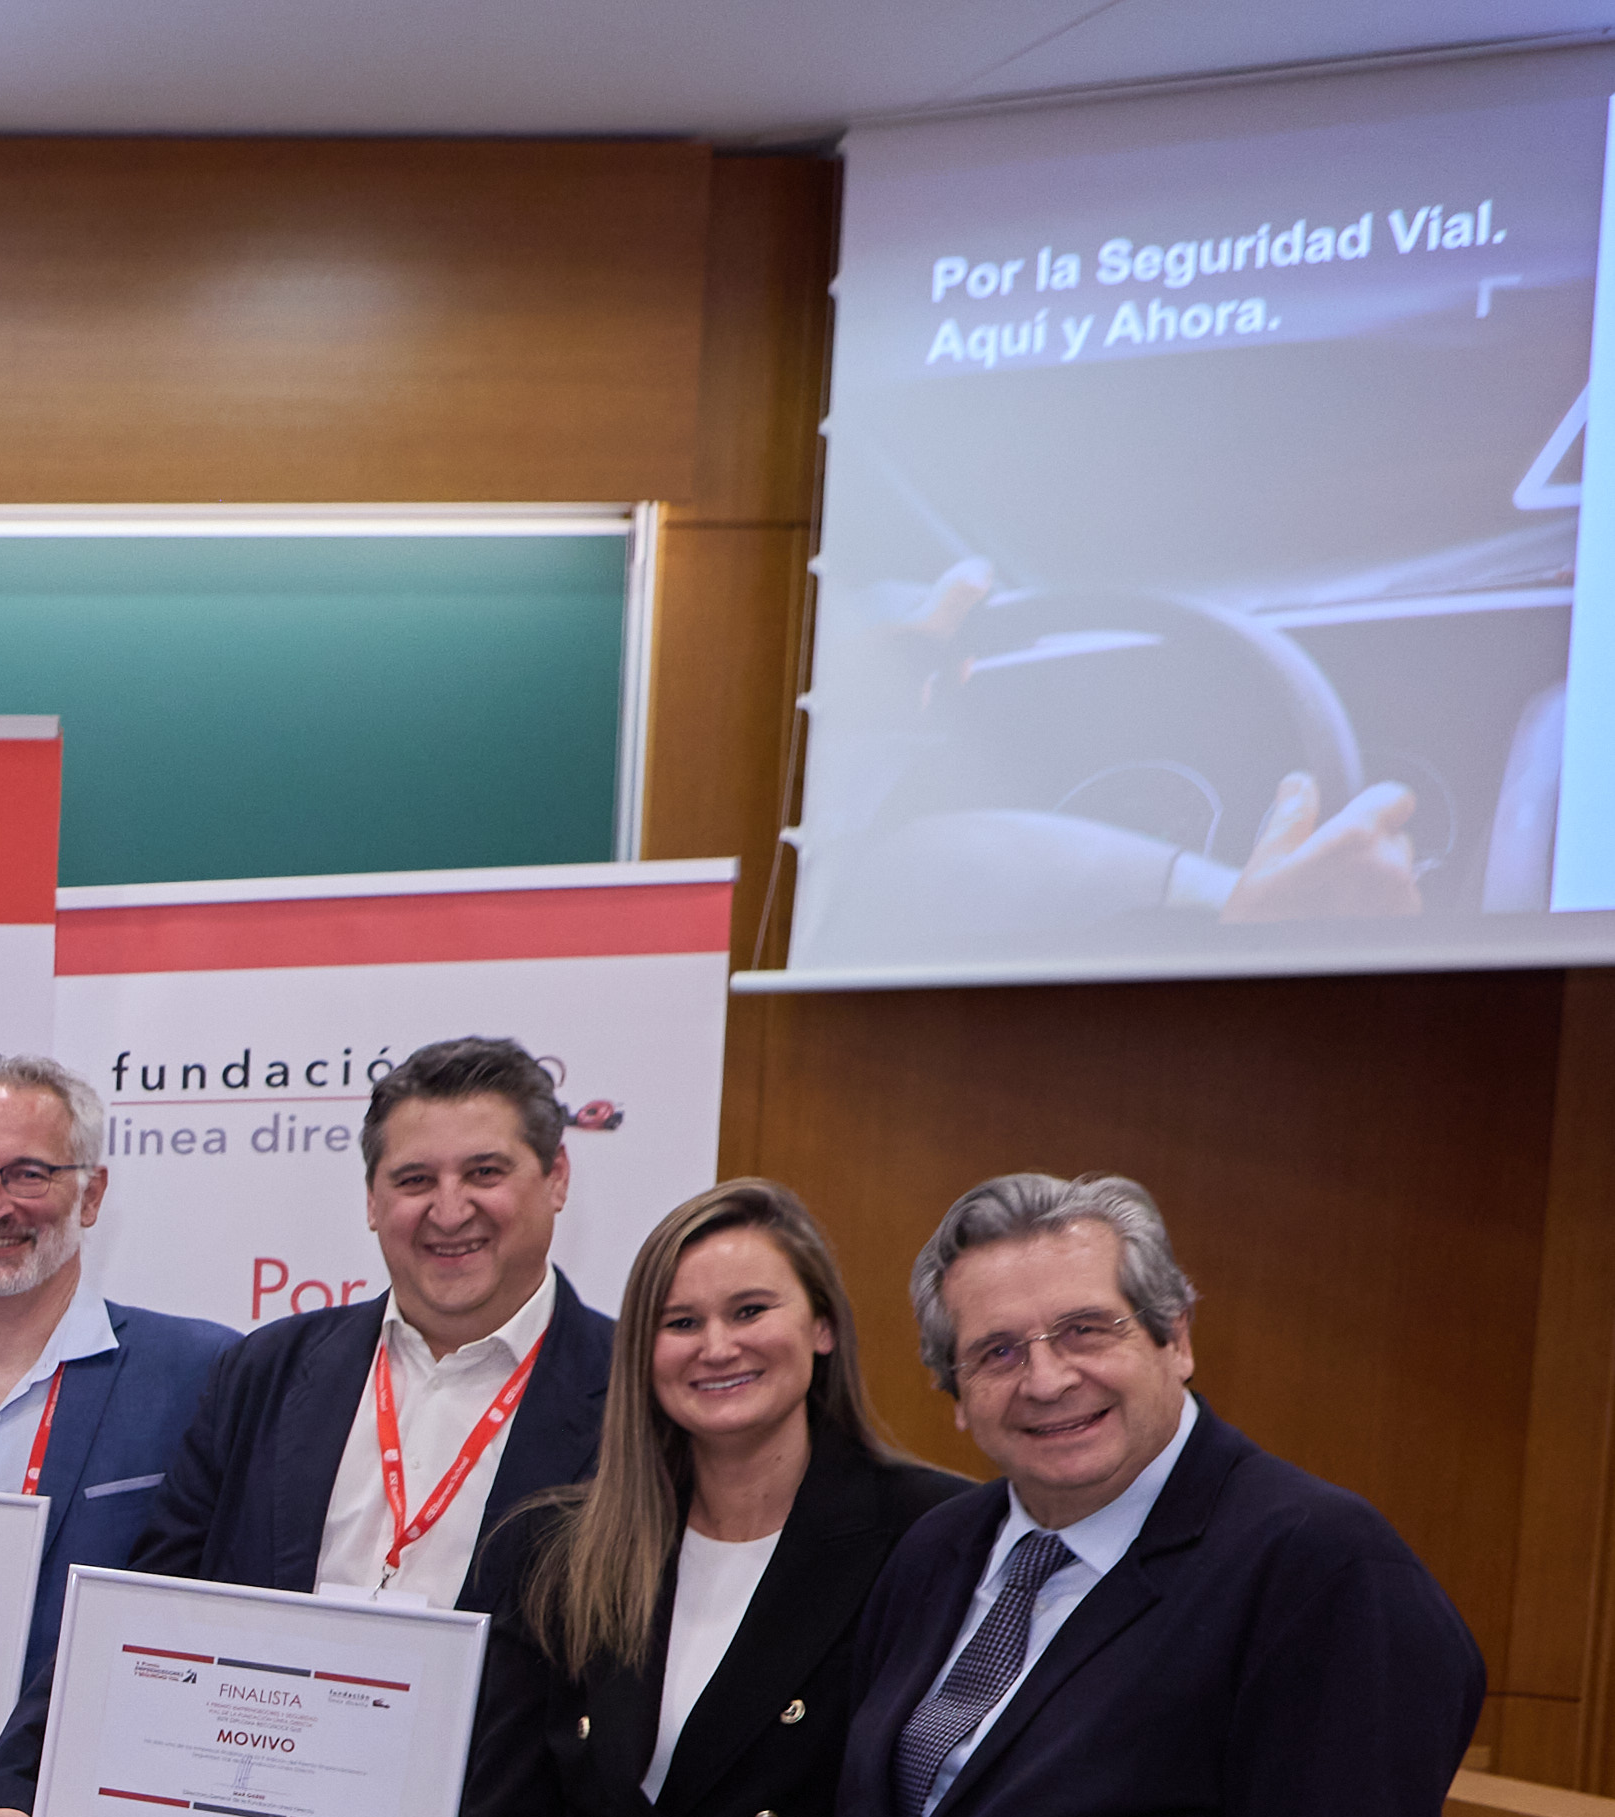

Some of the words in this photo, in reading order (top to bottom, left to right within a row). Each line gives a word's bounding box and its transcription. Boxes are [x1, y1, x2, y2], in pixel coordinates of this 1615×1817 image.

[932, 254, 1024, 301] Por
[1036, 247, 1080, 291] la
[1096, 211, 1372, 288] Seguridad
[1389, 200, 1506, 253] Vial.
[926, 300, 1047, 368] Aquí
[1060, 309, 1095, 361] y
[1105, 296, 1282, 347] Ahora.
[112, 1046, 394, 1091] fundació
[108, 1116, 227, 1156] linea
[251, 1112, 362, 1153] dire
[252, 1257, 368, 1320] Por
[220, 1683, 302, 1708] FINALISTA
[217, 1729, 295, 1753] MOVIVO
